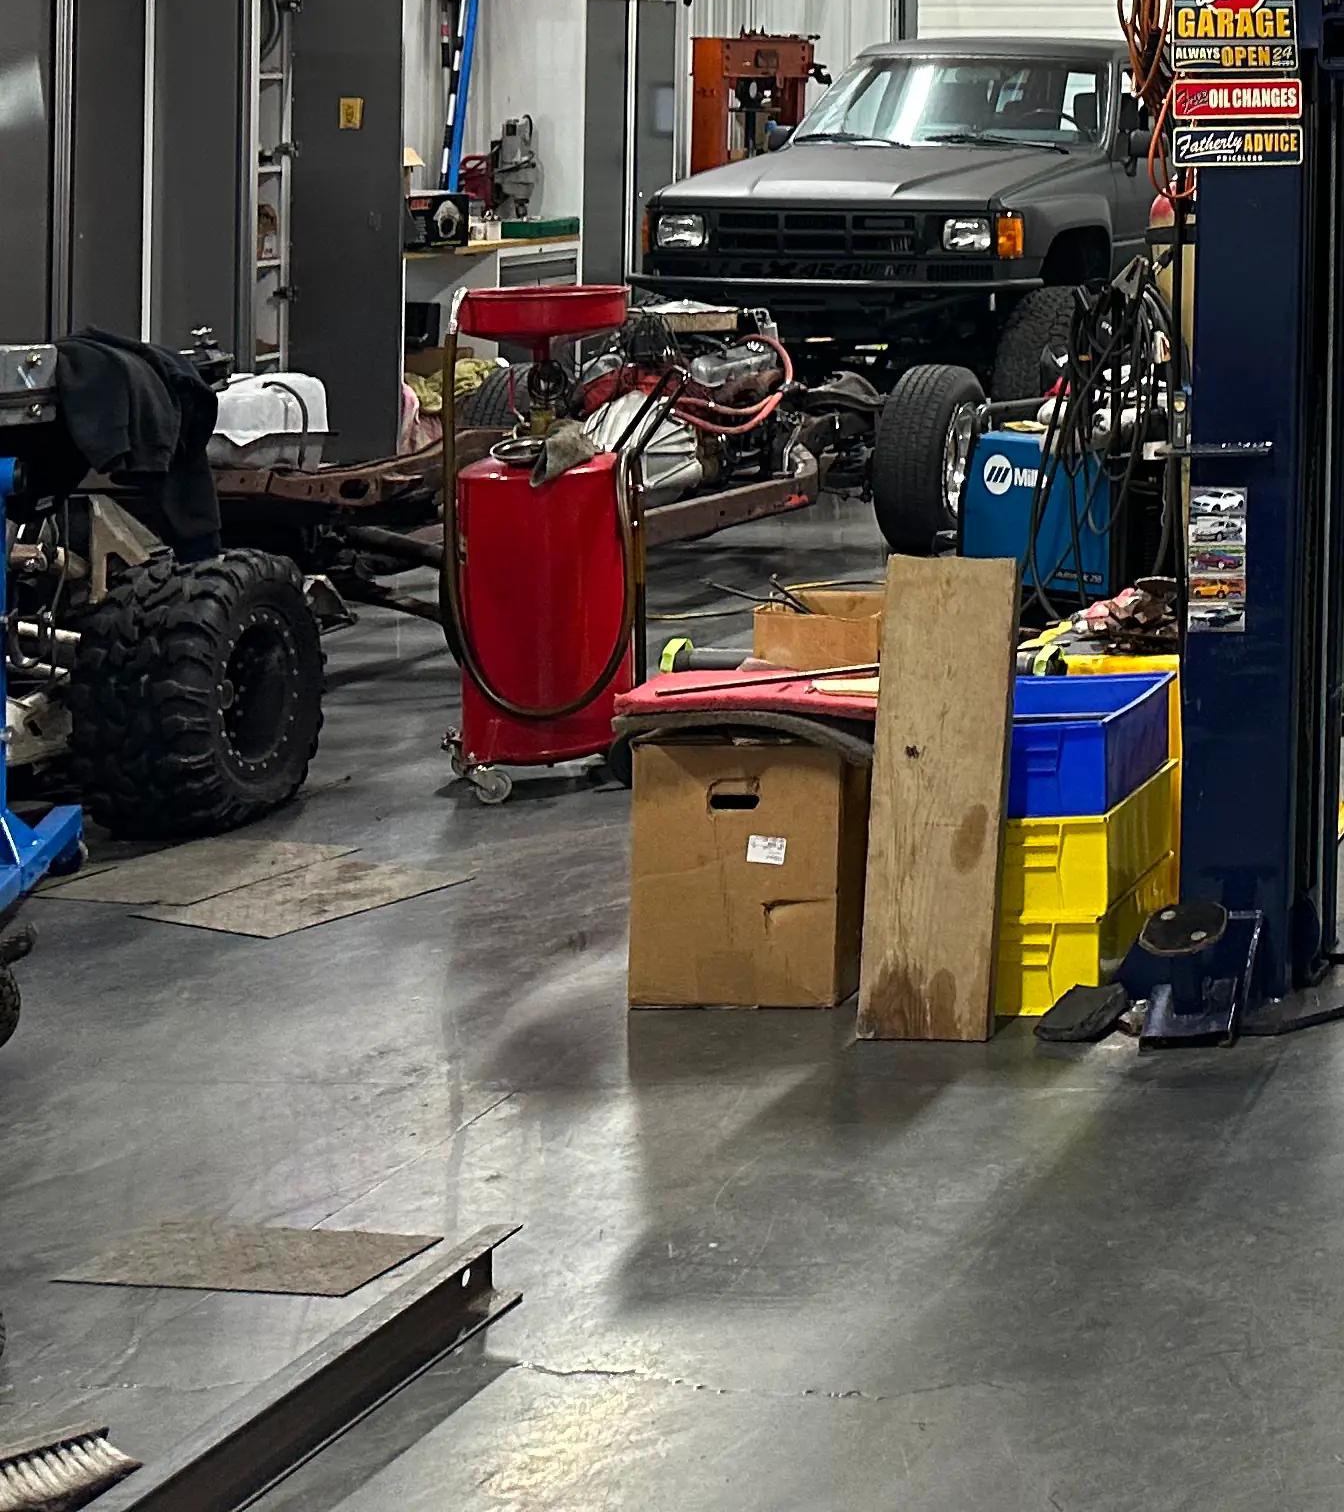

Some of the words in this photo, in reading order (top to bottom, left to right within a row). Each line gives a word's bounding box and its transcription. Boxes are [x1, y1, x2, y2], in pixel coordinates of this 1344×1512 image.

[1177, 8, 1291, 38] GARAGE
[1176, 47, 1220, 60] ALWAYS
[1221, 46, 1271, 67] OPEN
[1272, 45, 1292, 60] 24
[1208, 88, 1231, 108] OIL
[1232, 87, 1298, 108] CHANGES
[1177, 132, 1243, 158] Fatherly
[1244, 132, 1298, 153] ADVICE
[1013, 467, 1048, 489] Mill
